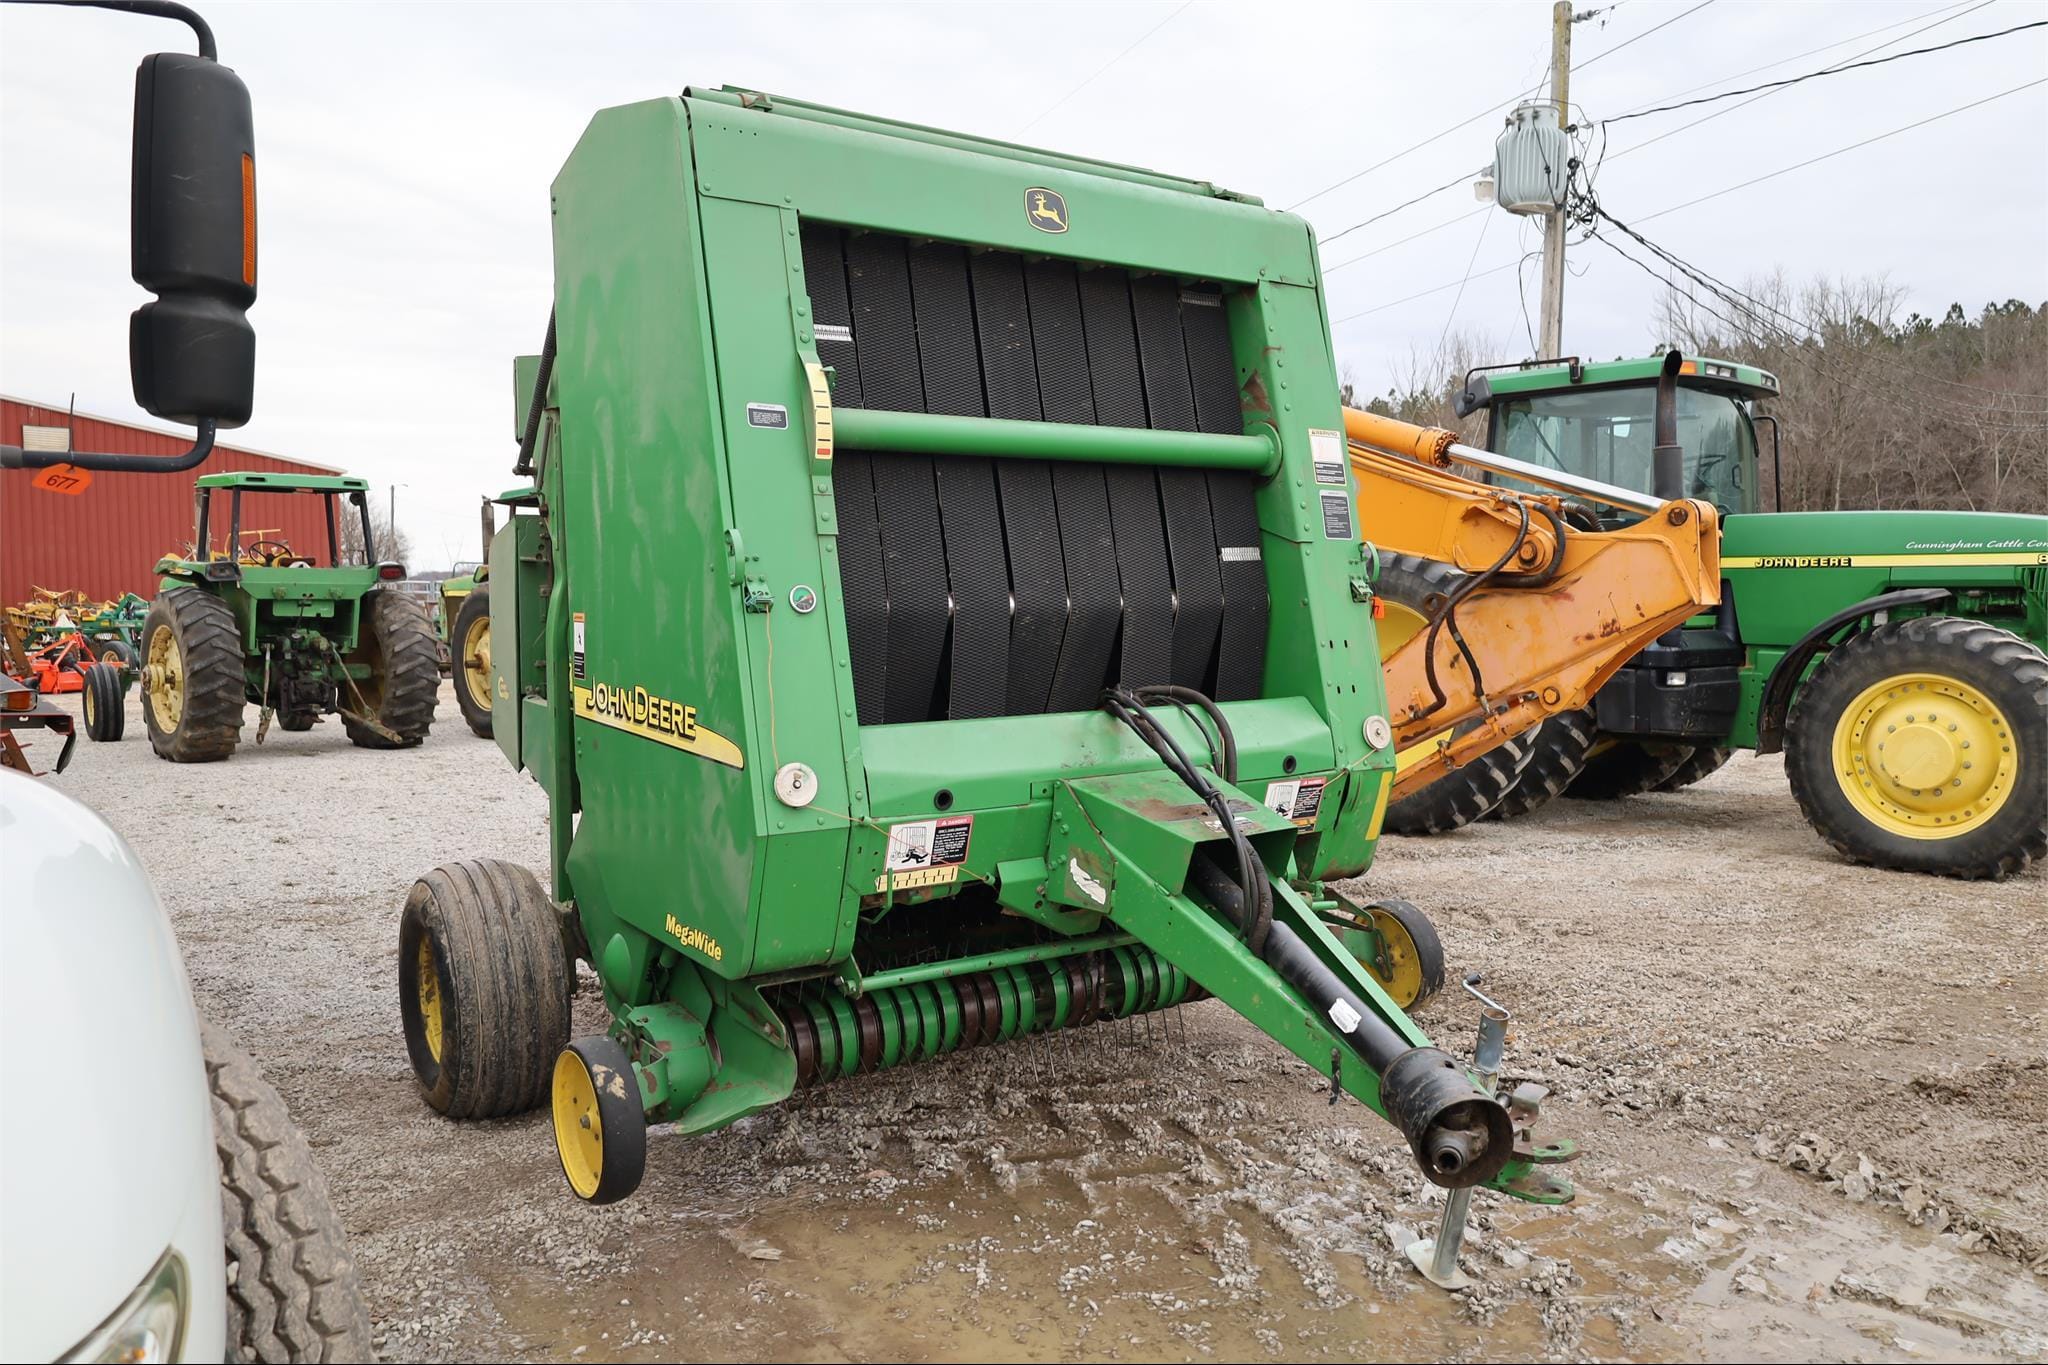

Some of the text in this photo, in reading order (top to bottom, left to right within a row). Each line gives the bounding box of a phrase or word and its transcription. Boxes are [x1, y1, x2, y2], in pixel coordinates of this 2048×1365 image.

[46, 474, 80, 490] 677
[1905, 539, 1983, 552] Cunningham
[1986, 538, 2024, 549] Cattle
[1755, 556, 1852, 567] JOHN DEERE
[586, 675, 632, 721] JOHN
[634, 685, 696, 741] DEERE
[665, 913, 722, 961] MegaWide
